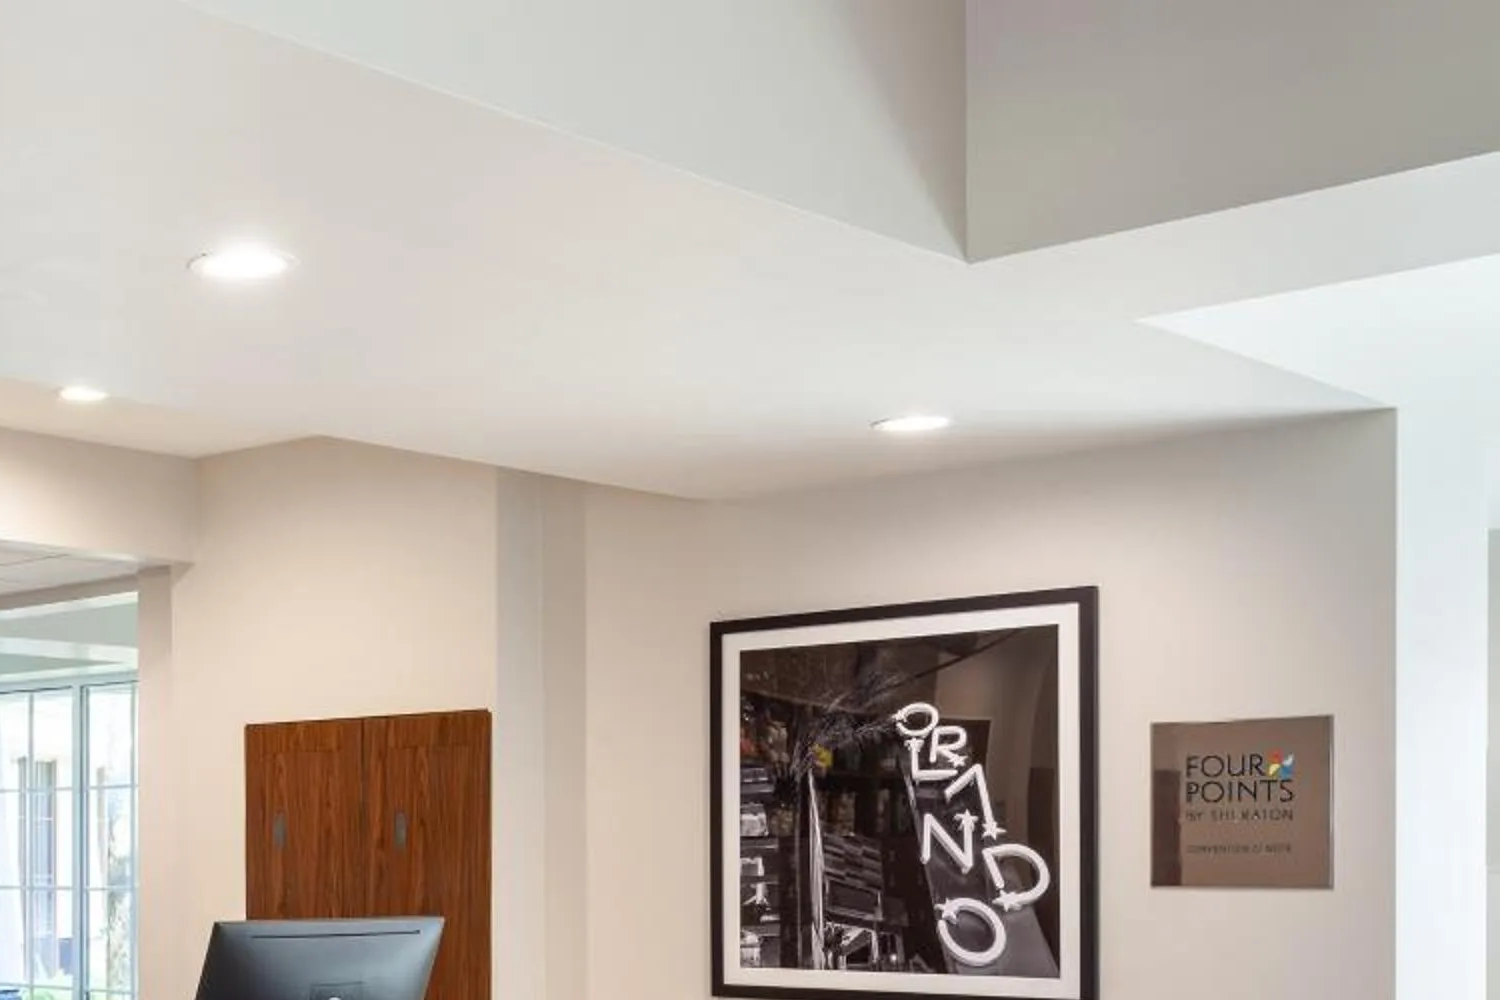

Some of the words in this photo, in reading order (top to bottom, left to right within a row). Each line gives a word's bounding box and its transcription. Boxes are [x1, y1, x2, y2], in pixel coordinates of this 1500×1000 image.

[1186, 754, 1265, 778] FOUR
[1186, 779, 1294, 803] POINTS
[893, 702, 1051, 966] ORLANDO
